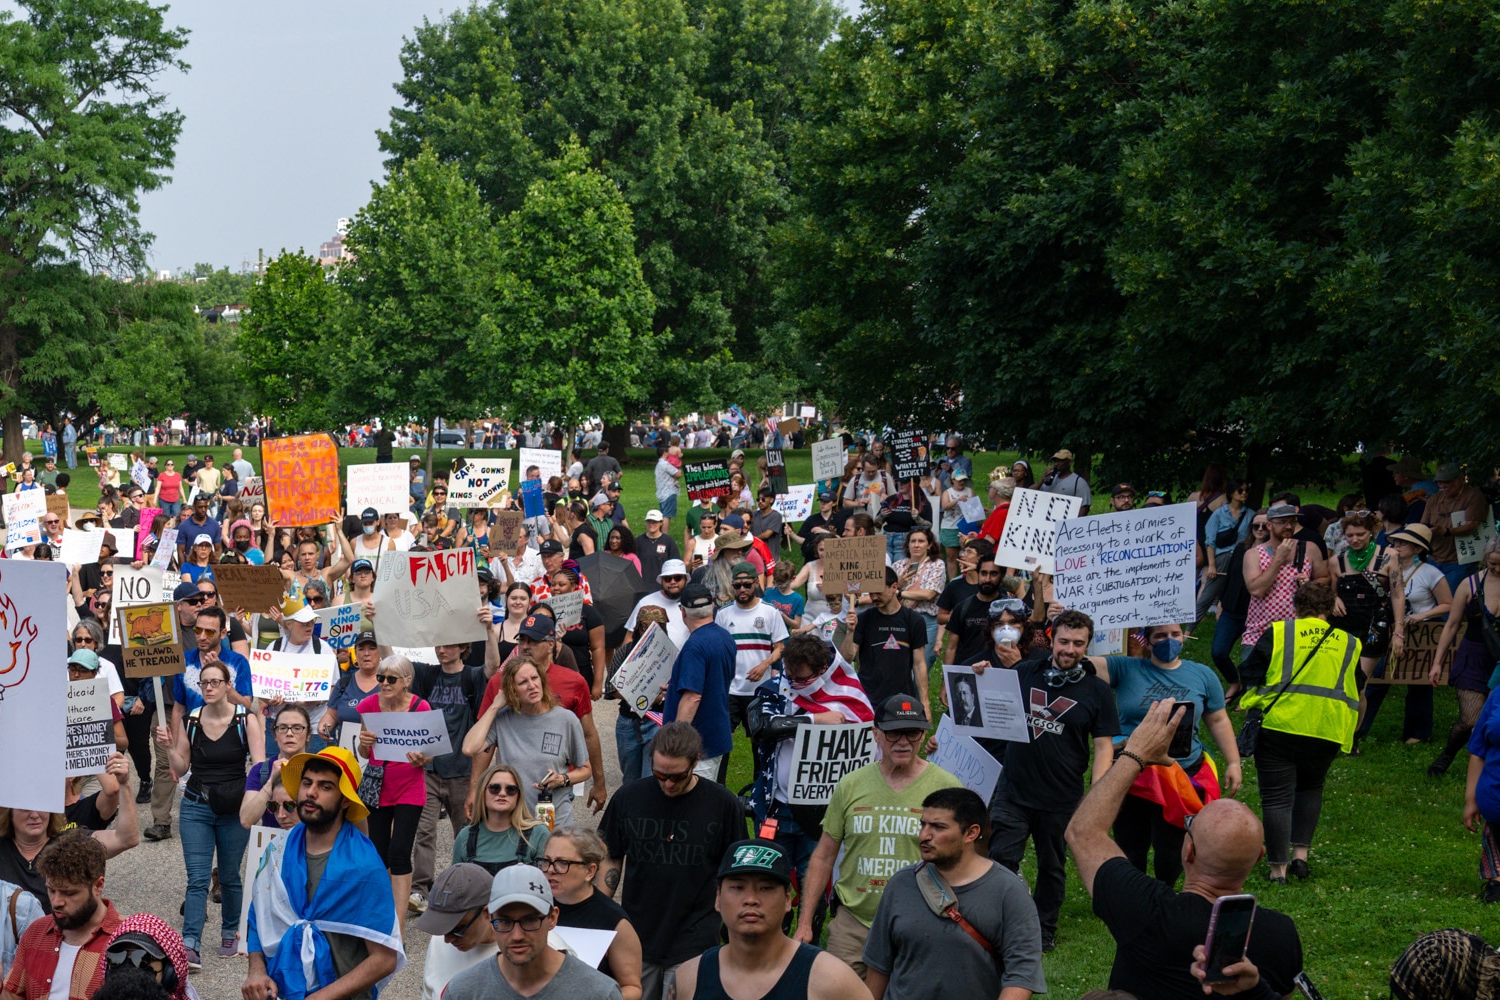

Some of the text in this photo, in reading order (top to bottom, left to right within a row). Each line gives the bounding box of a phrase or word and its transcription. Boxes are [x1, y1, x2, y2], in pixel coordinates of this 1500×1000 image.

[264, 439, 331, 453] These are
[891, 437, 913, 445] STUDENTS
[767, 450, 784, 467] LEGAL
[895, 462, 917, 470] WHAT'S
[265, 456, 335, 480] DEATH
[455, 463, 475, 480] CAPS
[685, 462, 723, 473] They blame
[685, 469, 729, 482] IMMIGRANTS
[714, 478, 730, 487] blame
[266, 477, 334, 500] THROES
[468, 479, 490, 488] NOT
[478, 480, 507, 501] CROWNS
[358, 497, 397, 505] RADICAL
[689, 487, 731, 500] BILLIONAIRES
[1016, 491, 1071, 522] NO
[1056, 516, 1175, 544] Are fleets armies
[832, 540, 878, 548] LAST TIME
[1055, 527, 1186, 558] necessary to of
[826, 549, 879, 559] AMERICA HAD
[1055, 539, 1195, 572] LOVE RECONCILIATION?
[409, 548, 474, 588] FASCIST
[866, 561, 876, 569] IT
[1055, 554, 1191, 586] These are the implements of
[214, 567, 244, 580] REAL
[847, 571, 883, 580] END WELL
[120, 576, 151, 600] NO
[1056, 571, 1184, 600] WAR SUBJUGATION; the
[394, 589, 455, 620] USA
[1080, 585, 1180, 612] arguments to which
[338, 606, 352, 616] NO
[1100, 609, 1144, 625] resort.
[330, 614, 360, 626] KINGS
[341, 624, 353, 633] IN
[133, 649, 145, 657] OH
[252, 651, 272, 661] NO
[126, 655, 180, 668] HE TREADIN
[252, 663, 329, 679] DICTATORS
[616, 667, 628, 689] DJT
[251, 674, 291, 689] SINCE
[1145, 680, 1191, 700] History
[82, 721, 107, 734] MONEY
[1026, 714, 1061, 734] NGSOC
[73, 731, 106, 746] PARADE
[383, 728, 430, 737] DEMAND
[376, 734, 442, 747] DEMOCRACY
[801, 727, 873, 760] I HAVE
[89, 746, 110, 757] MONEY
[938, 727, 985, 786] REMINDS
[853, 815, 873, 834] NO
[879, 836, 896, 856] IN
